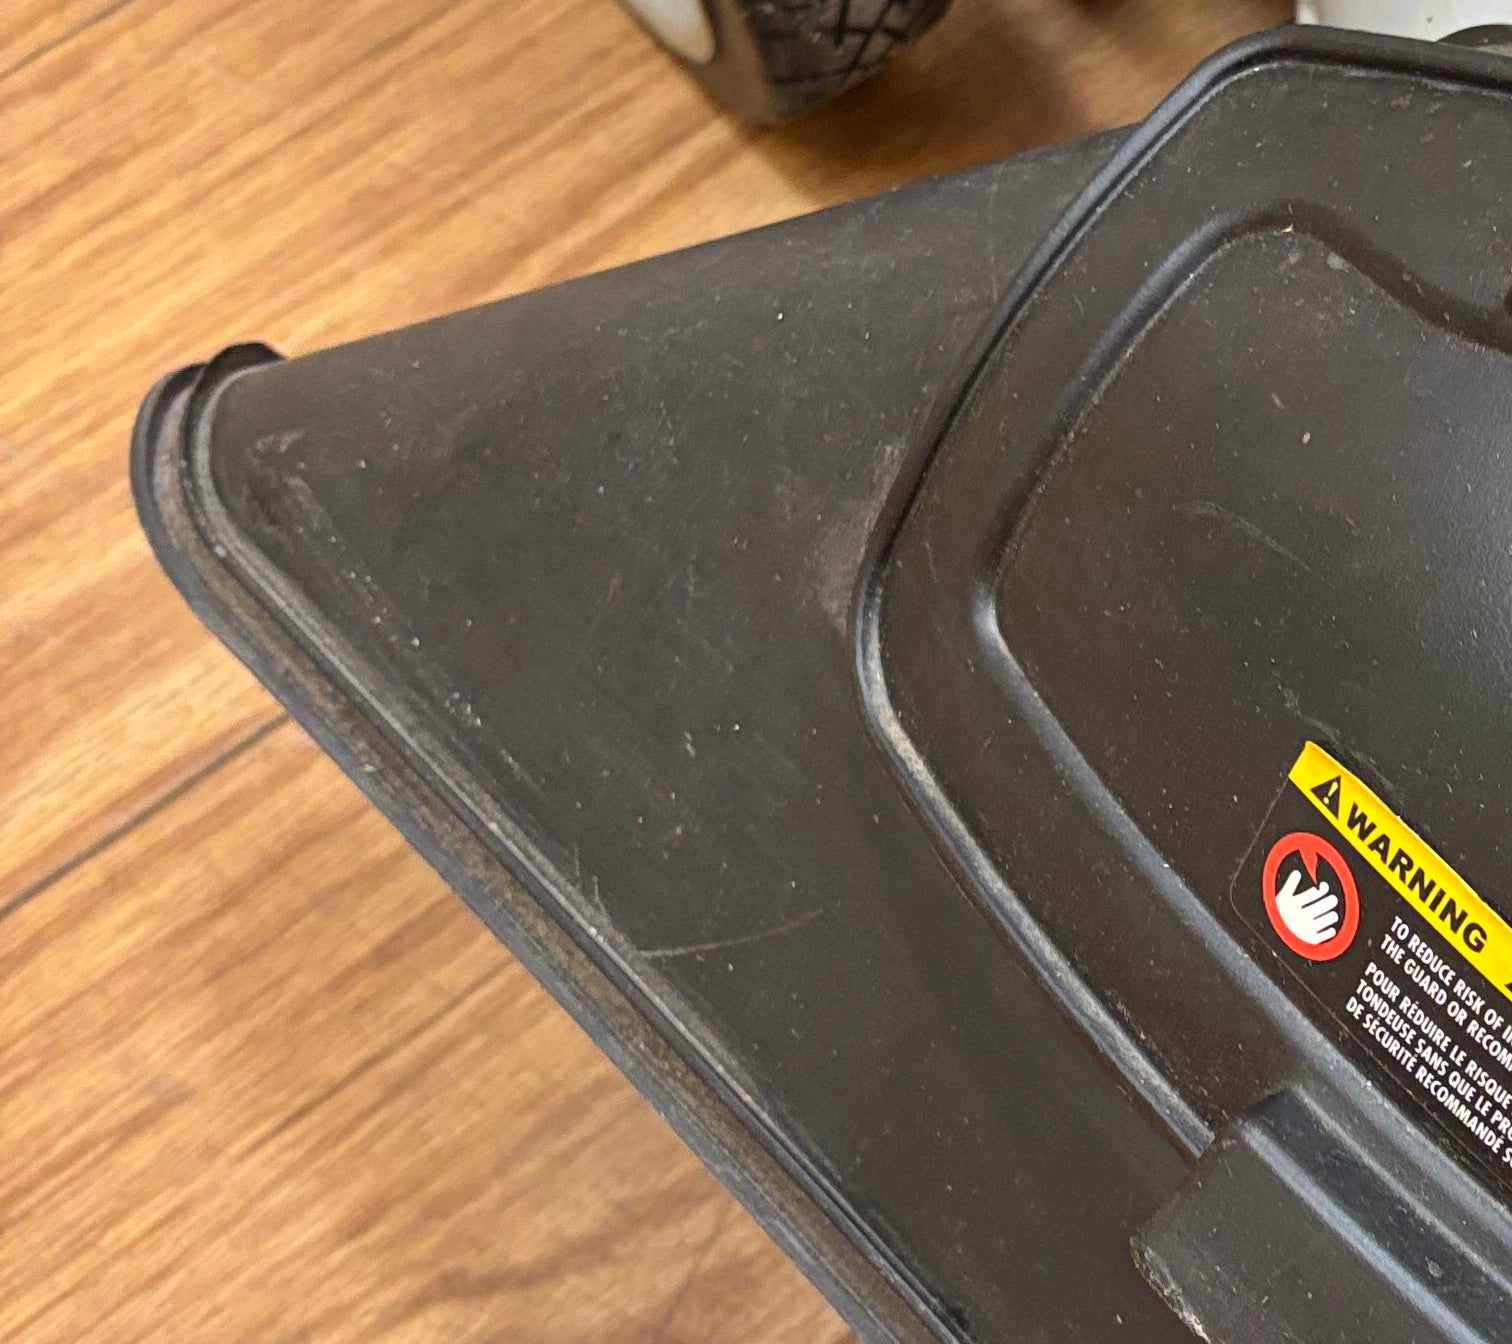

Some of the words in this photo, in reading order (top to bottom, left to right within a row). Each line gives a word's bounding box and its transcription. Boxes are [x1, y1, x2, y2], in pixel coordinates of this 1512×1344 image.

[1347, 802, 1487, 953] WARNING
[1345, 995, 1365, 1020] DE
[1364, 961, 1400, 1002] POUR
[1448, 1044, 1467, 1067] LE
[1380, 932, 1406, 965] THE
[1403, 957, 1447, 1005] GUARD
[1446, 1000, 1468, 1026] OR
[1390, 915, 1409, 940] TO
[1406, 933, 1456, 986] REDUCE
[1452, 977, 1486, 1015] RISK
[1483, 1007, 1504, 1030] OF
[1355, 977, 1417, 1045] TONDEUSE
[1413, 1037, 1449, 1076] SANS
[1447, 1070, 1476, 1102] QUE
[1473, 1094, 1492, 1116] LE
